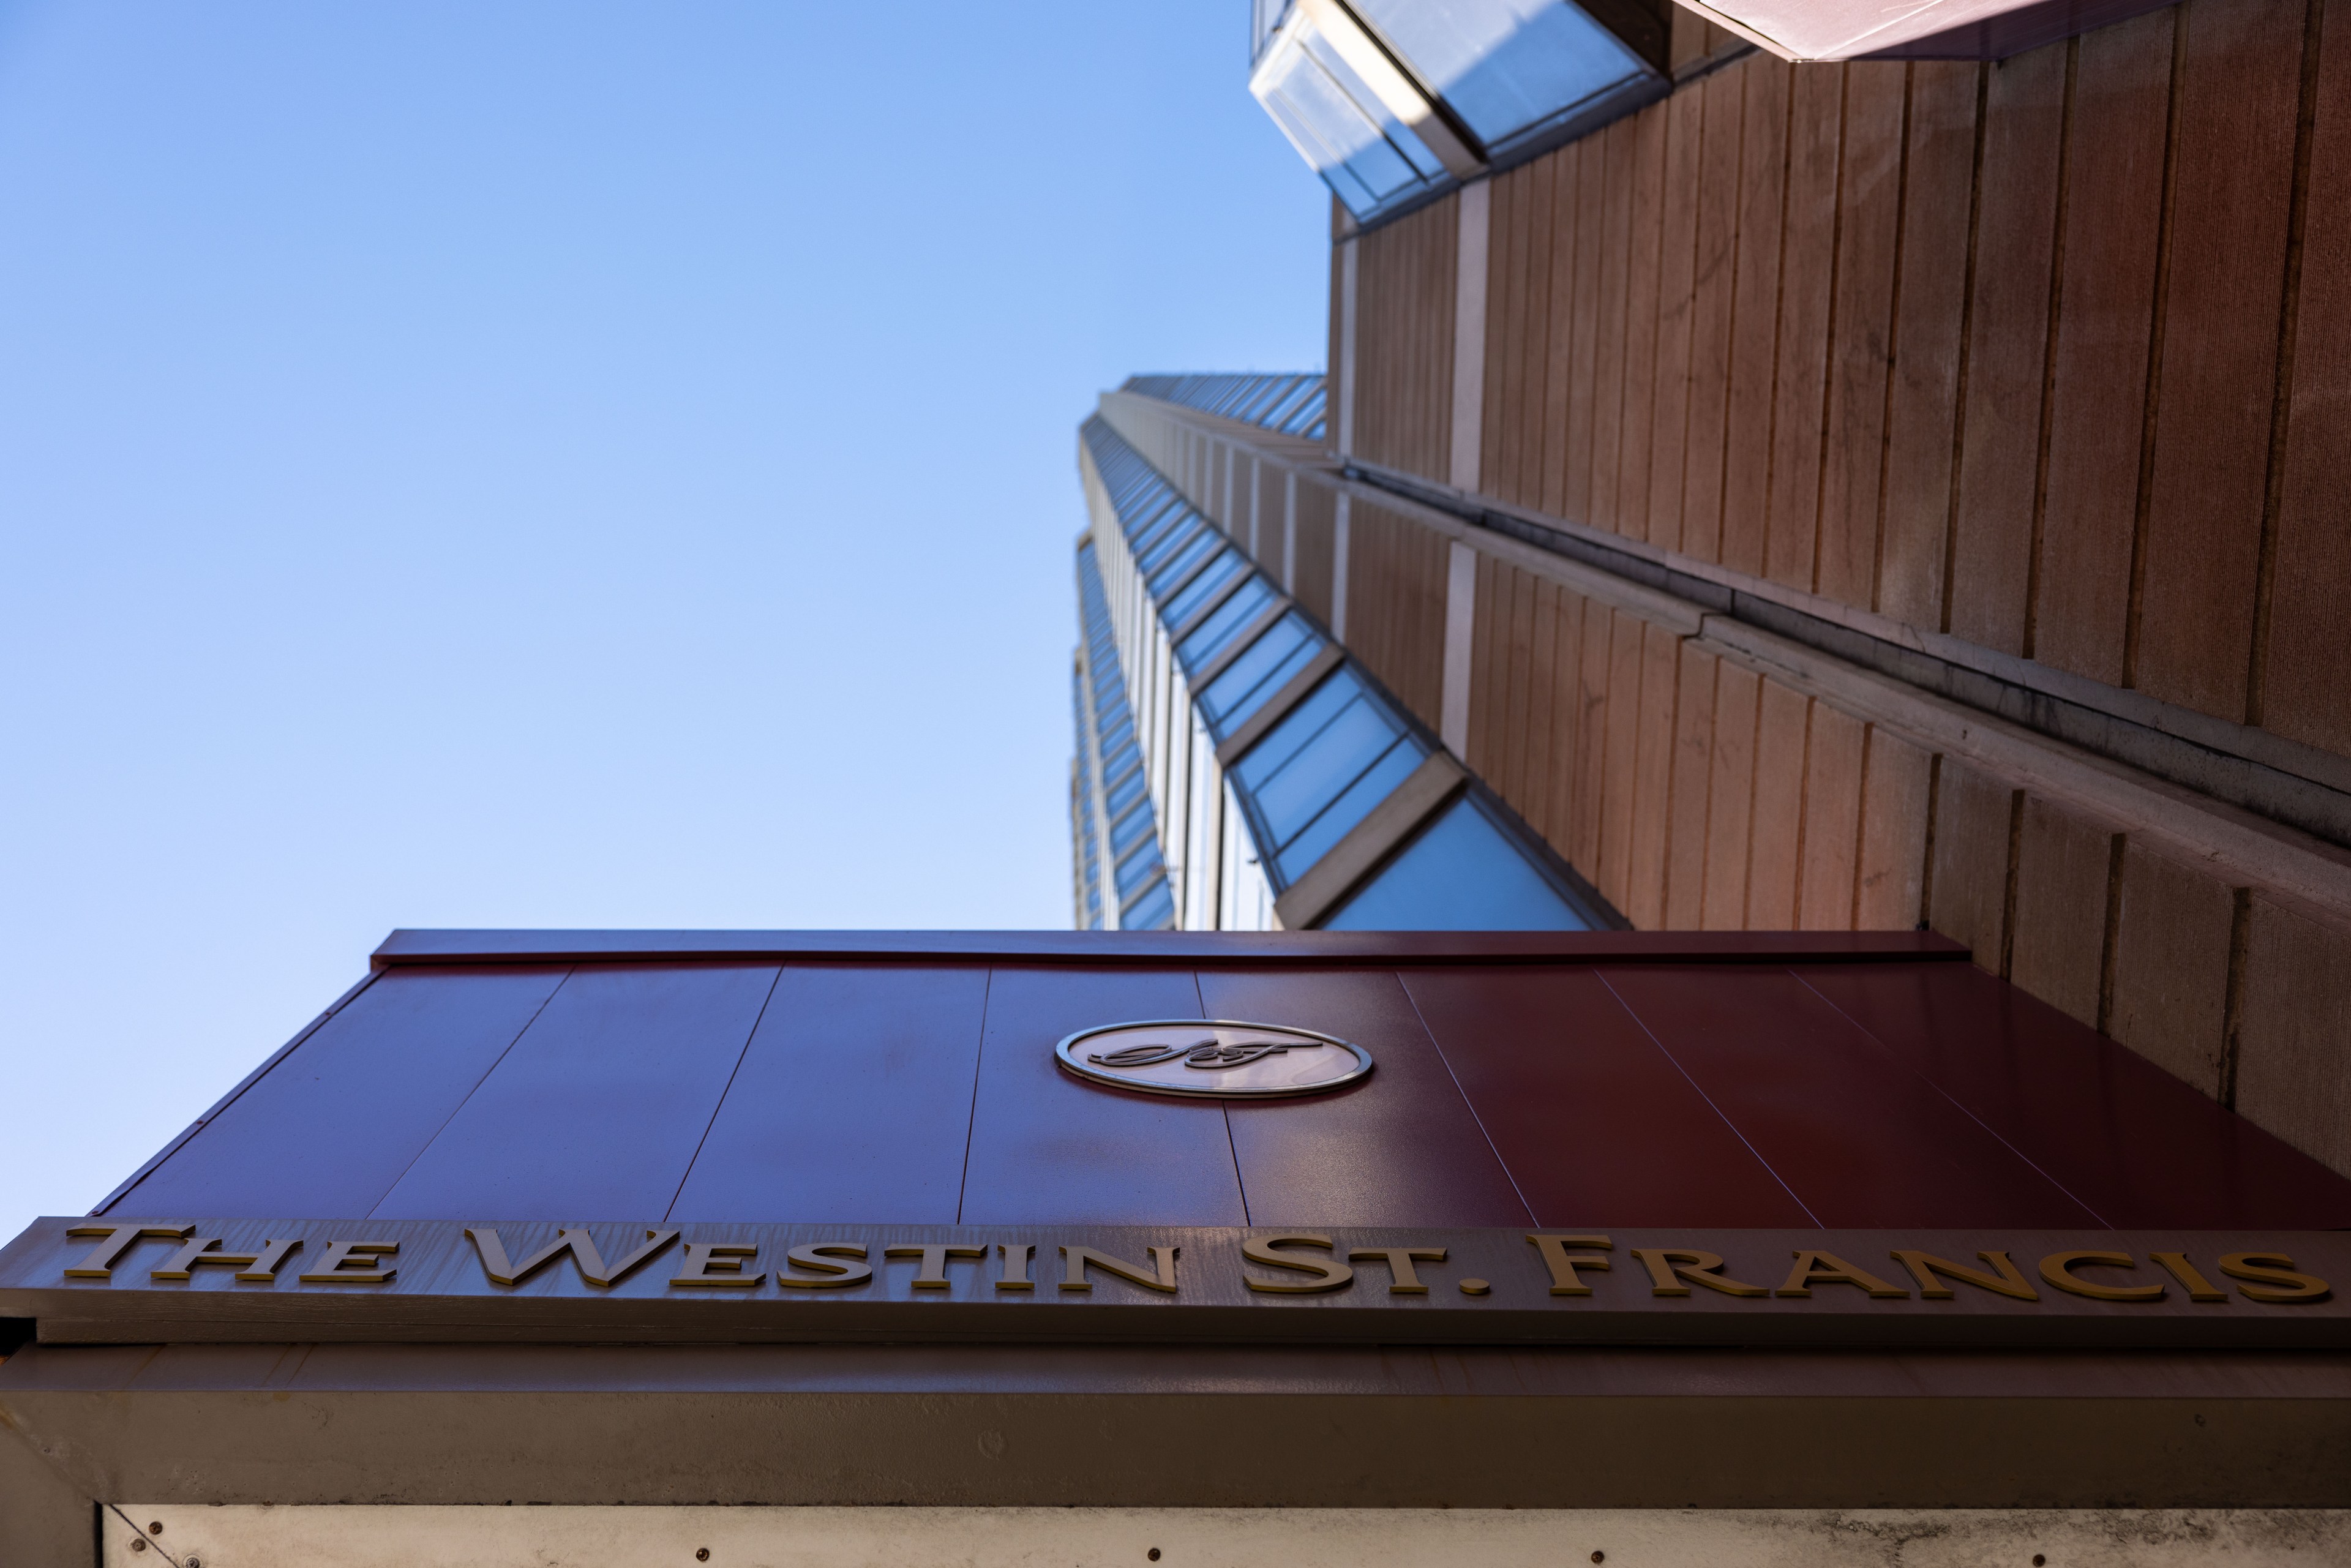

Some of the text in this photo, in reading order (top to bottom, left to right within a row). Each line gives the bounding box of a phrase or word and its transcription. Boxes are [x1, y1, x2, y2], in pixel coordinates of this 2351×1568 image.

[64, 1224, 2330, 1303] THE WESTIN ST. FRANCIS
